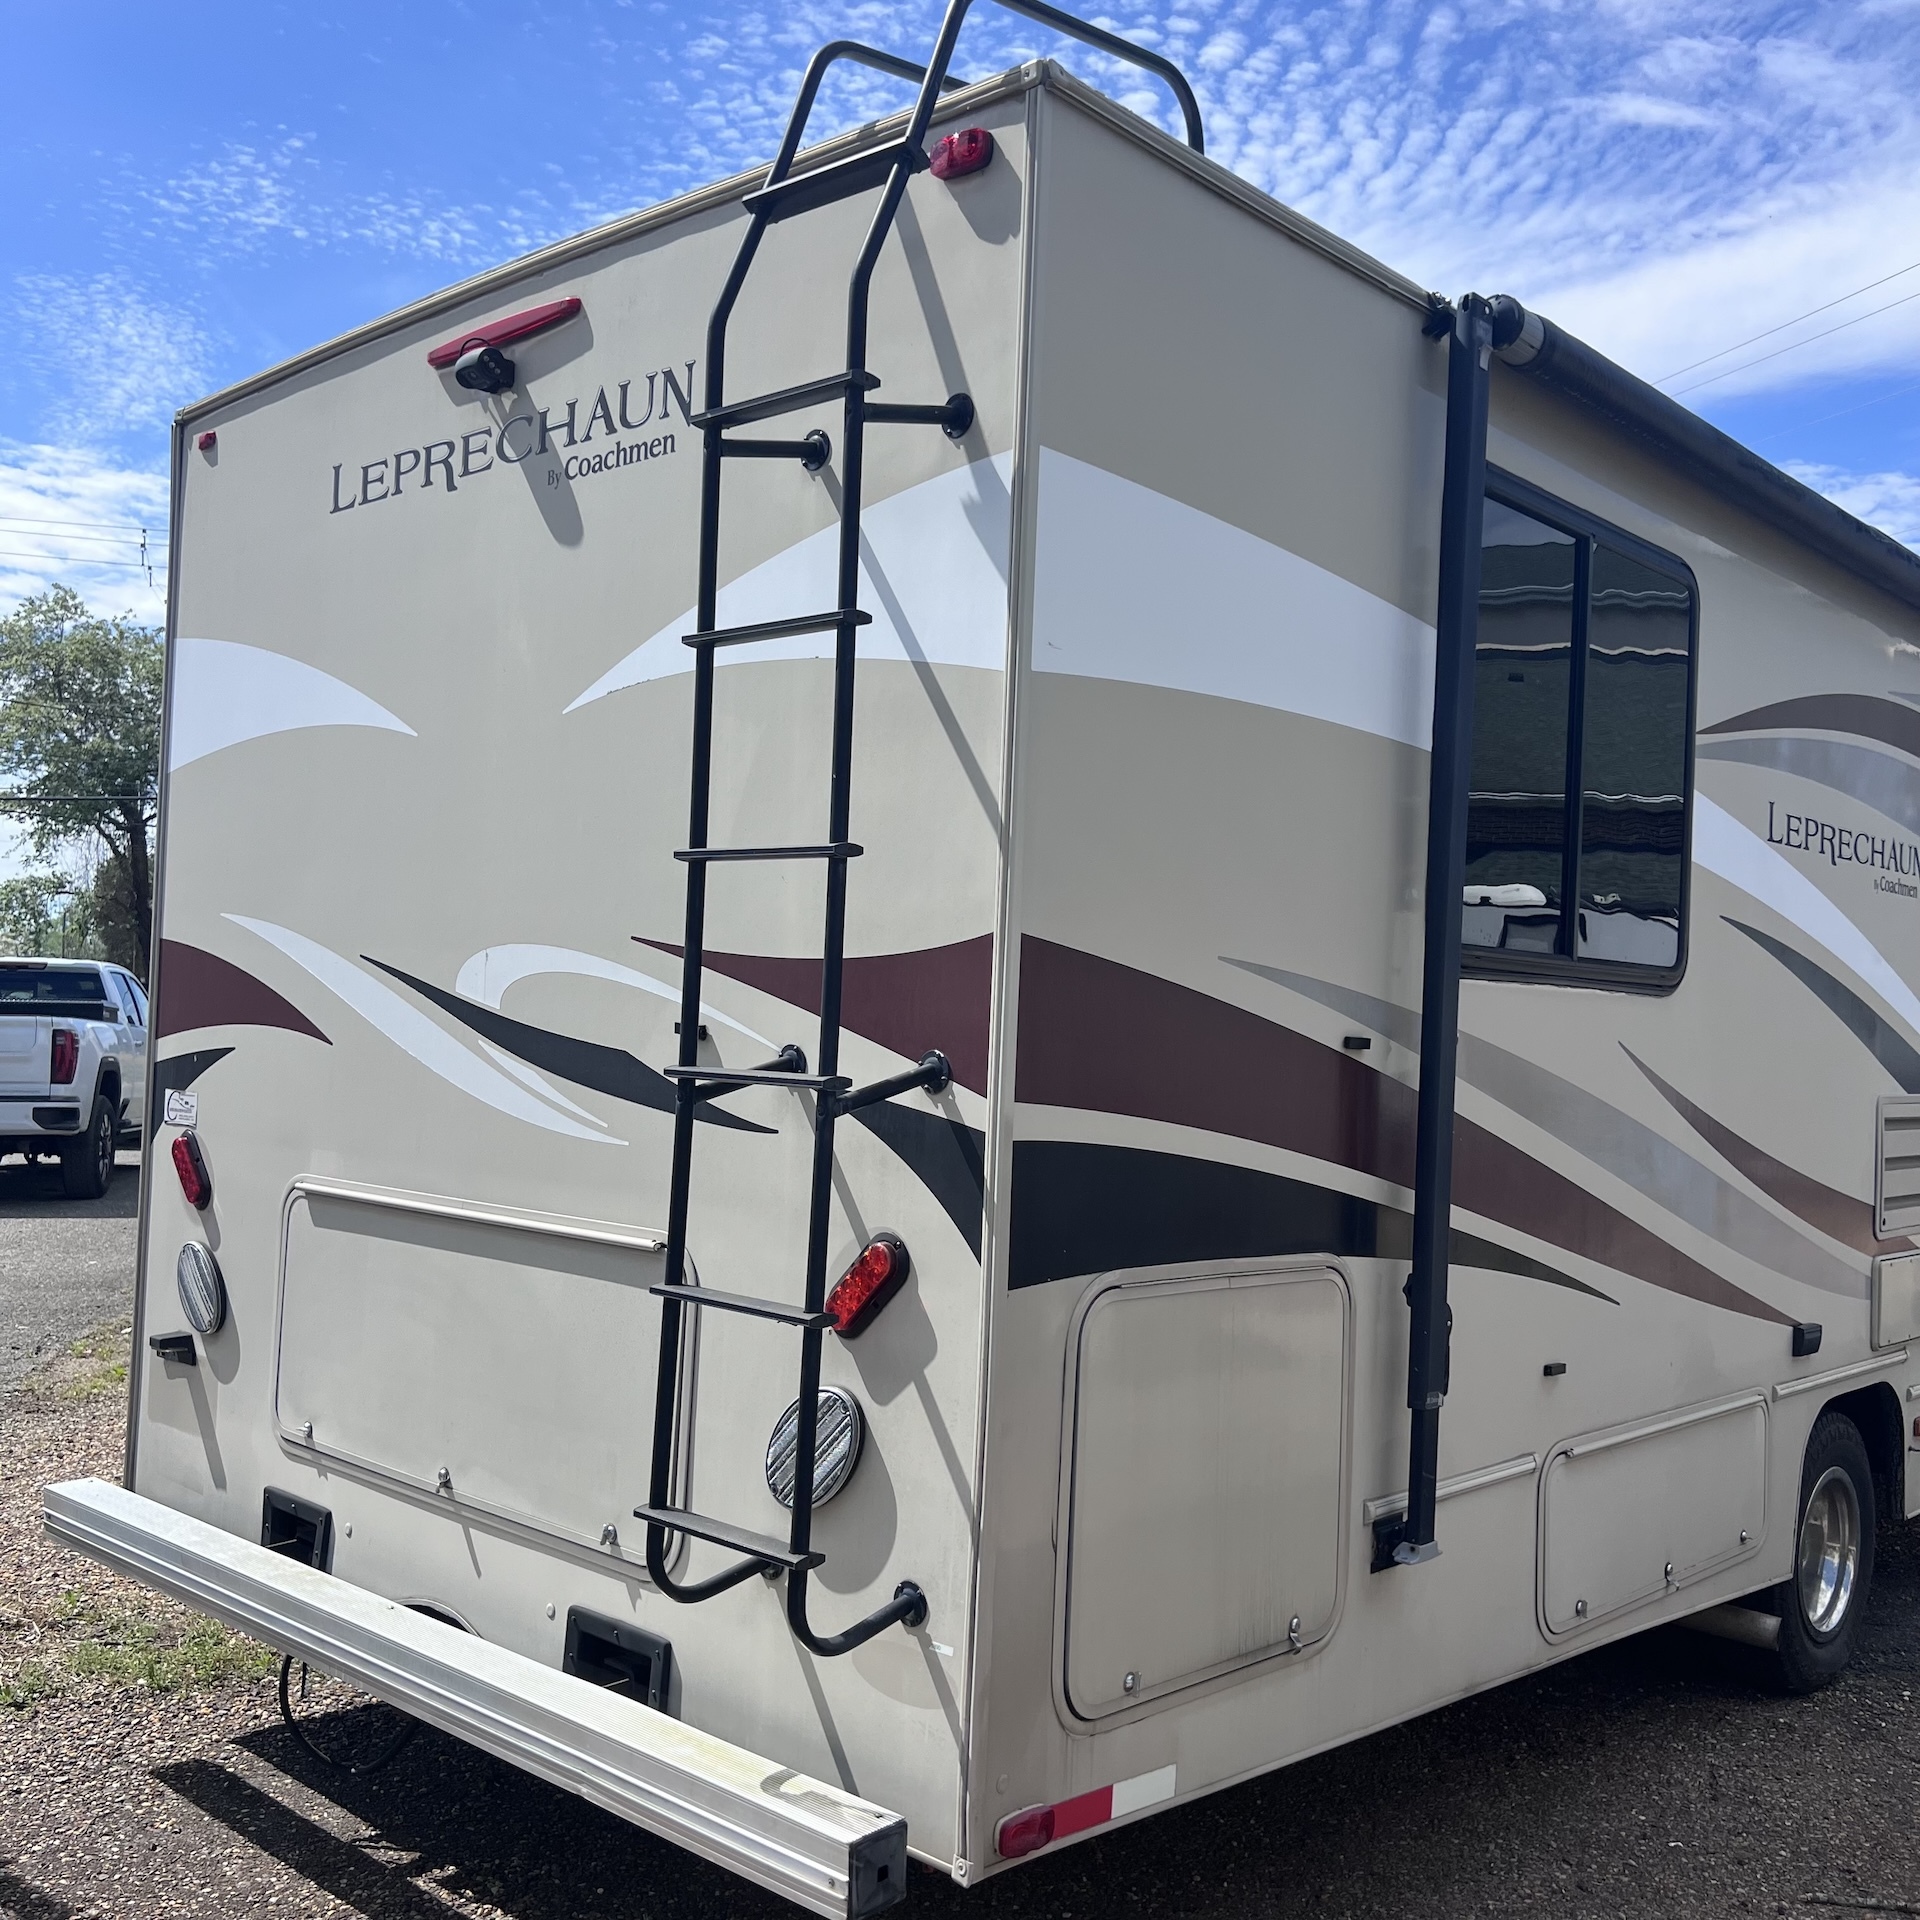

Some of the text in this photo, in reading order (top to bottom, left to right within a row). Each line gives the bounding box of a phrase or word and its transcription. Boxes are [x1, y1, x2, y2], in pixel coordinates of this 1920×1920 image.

[329, 360, 697, 514] LEPRECHAUN
[547, 434, 676, 489] By Coachmen
[1880, 876, 1918, 899] Coachmen
